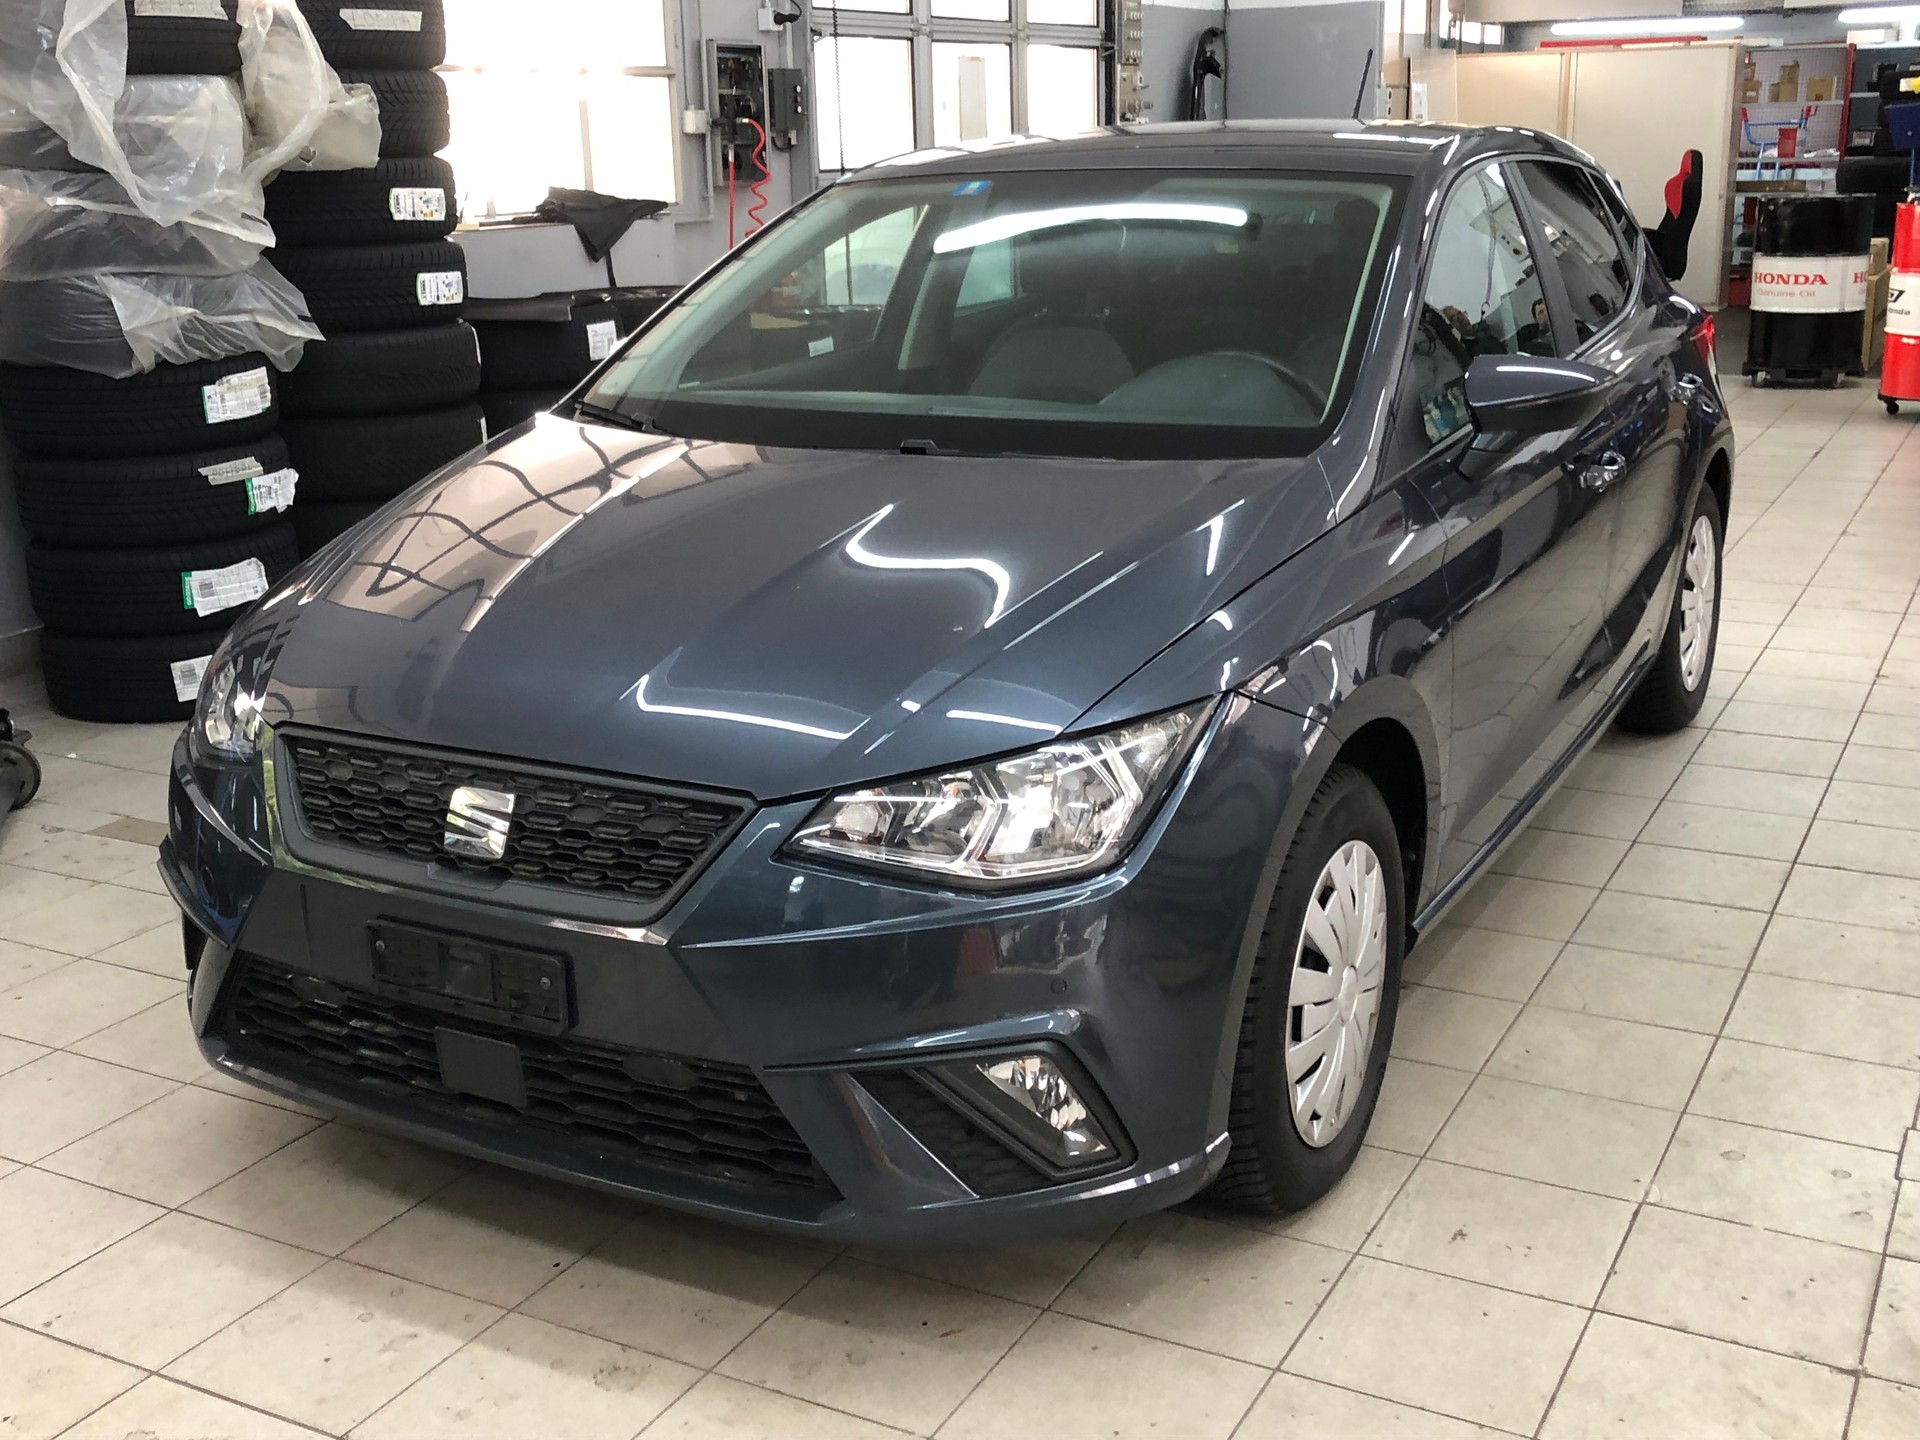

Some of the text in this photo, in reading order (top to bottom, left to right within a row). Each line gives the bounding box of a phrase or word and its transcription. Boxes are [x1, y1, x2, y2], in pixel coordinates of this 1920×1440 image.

[1754, 272, 1829, 286] HONDA
[1757, 288, 1816, 298] Genuine Oil
[1887, 307, 1911, 316] onda
